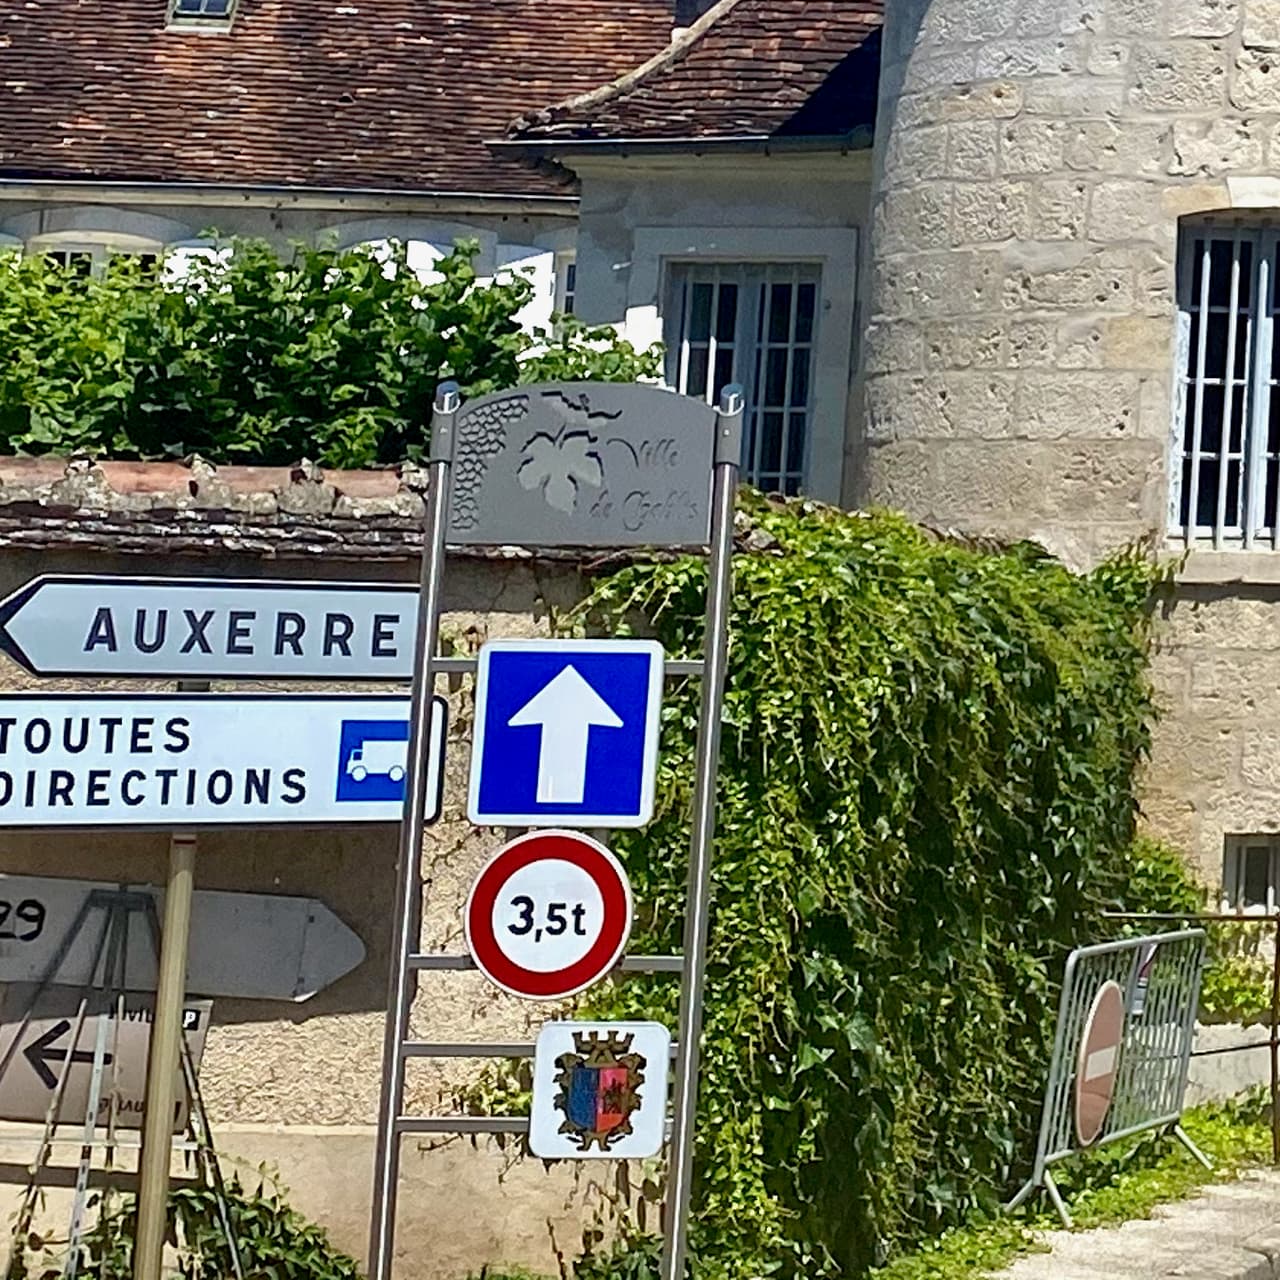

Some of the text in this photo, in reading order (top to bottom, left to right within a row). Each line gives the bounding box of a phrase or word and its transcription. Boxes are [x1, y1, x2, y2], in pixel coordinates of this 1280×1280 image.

[606, 437, 678, 468] Ville
[83, 607, 401, 658] AUXERRE
[0, 717, 191, 754] TOUTES
[507, 894, 587, 943] 3,5t
